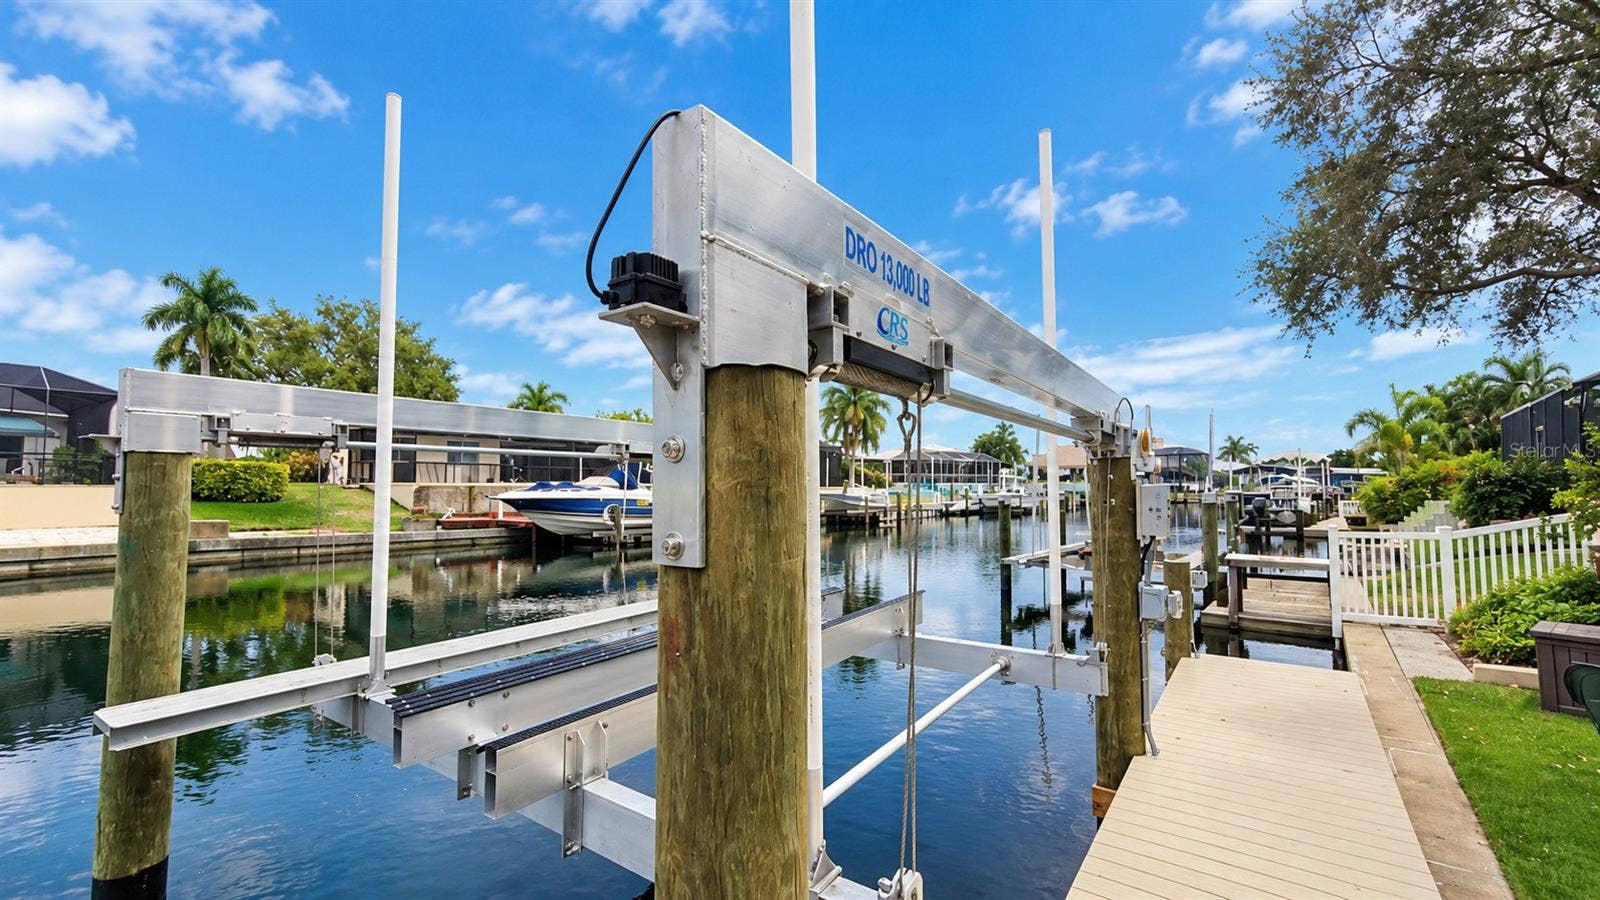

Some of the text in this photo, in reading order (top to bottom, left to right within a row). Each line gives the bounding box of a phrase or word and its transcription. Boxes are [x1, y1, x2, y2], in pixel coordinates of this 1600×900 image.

[845, 226, 929, 307] DRO 13,000 LB
[877, 307, 908, 341] CRS
